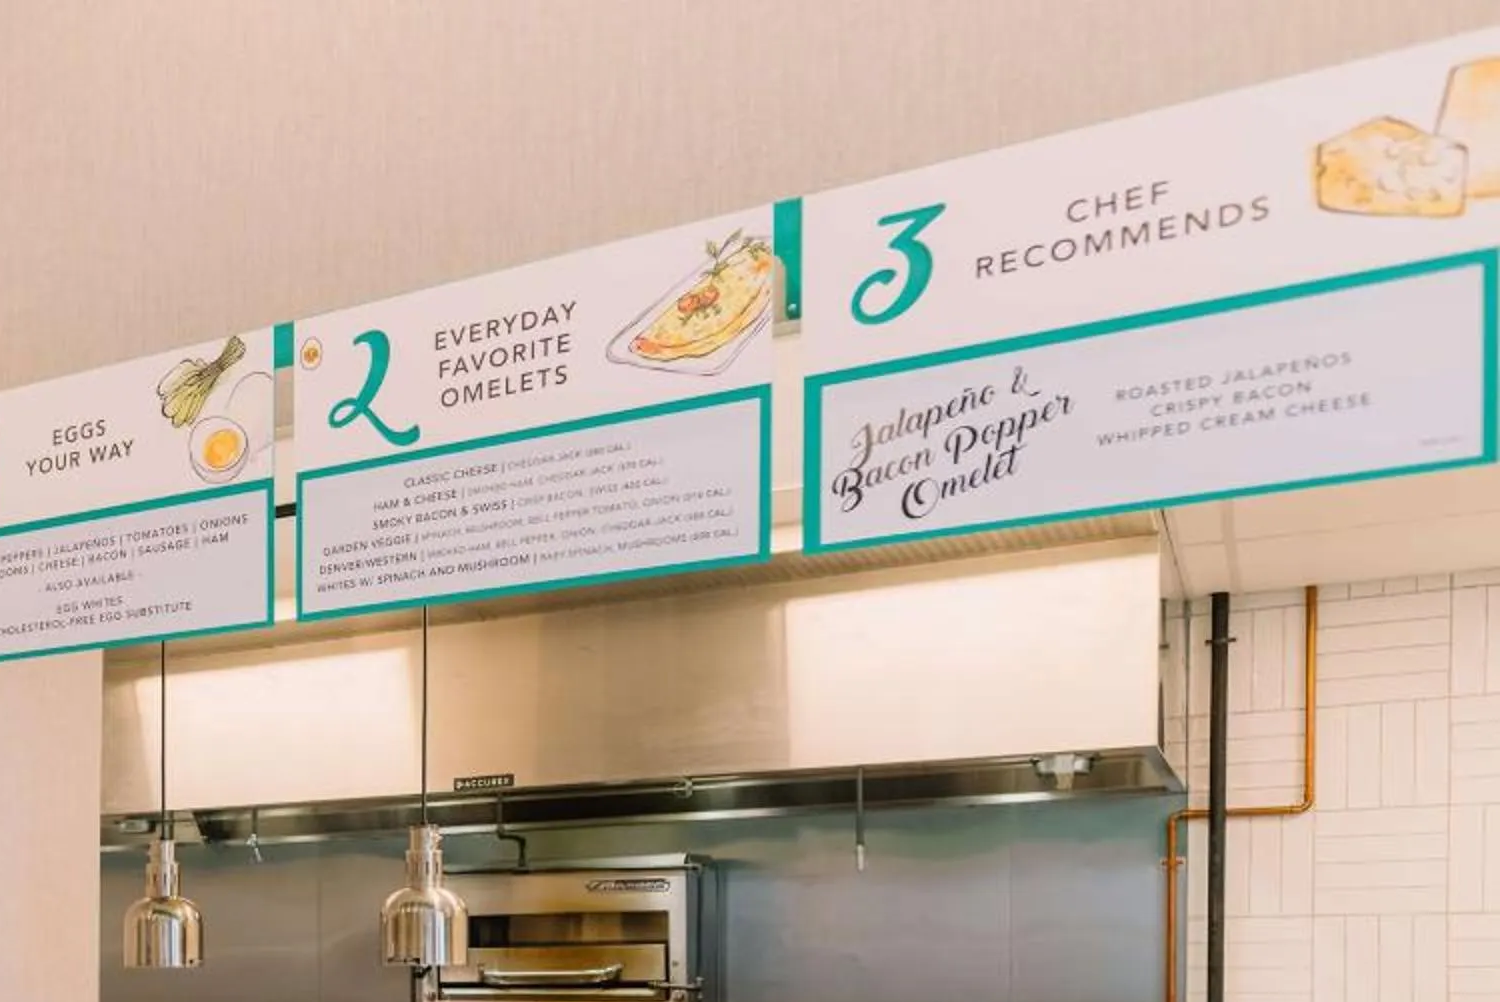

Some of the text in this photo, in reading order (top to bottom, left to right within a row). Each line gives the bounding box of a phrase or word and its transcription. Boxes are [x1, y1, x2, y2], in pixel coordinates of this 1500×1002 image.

[1066, 180, 1171, 224] CHEF
[974, 195, 1271, 280] RECOMMENDS
[850, 202, 947, 326] 3
[434, 301, 577, 351] EVERYDAY
[438, 333, 571, 379] FAVORITE
[327, 329, 420, 446] 2
[441, 365, 568, 408] OMELETS
[1115, 375, 1212, 401] ROASTED
[1150, 381, 1312, 418] CRISPY BACON
[52, 419, 106, 446] EGGS
[850, 365, 1041, 470] Jalapeño &
[1096, 392, 1372, 447] WHIPPED CREAM CHEESE
[26, 439, 135, 476] YOUR WAY
[831, 395, 1072, 513] Bacon Popper
[403, 470, 450, 489] CLASSIC
[454, 463, 498, 480] CHEESE
[901, 443, 1027, 519] Omelet
[372, 513, 413, 531] SMOKY
[415, 507, 458, 524] BACON
[472, 499, 508, 516] SWISS
[373, 496, 399, 512] HAM
[414, 488, 458, 506] CHEESE
[127, 523, 188, 542] TOMATOES
[200, 513, 249, 531] ONIONS
[323, 539, 368, 557] GARDEN
[371, 532, 412, 551] VEGGIE
[38, 556, 77, 572] CHEESE
[88, 549, 127, 565] BACON
[138, 537, 191, 557] SAUSAGE
[202, 531, 230, 545] HAM
[377, 569, 426, 586] SPINACH
[429, 564, 455, 579] AND
[457, 553, 530, 574] MUSHROOM
[56, 596, 123, 615] EGG WHITES
[100, 610, 122, 623] EGG
[126, 600, 192, 620] SUBSTITUTE
